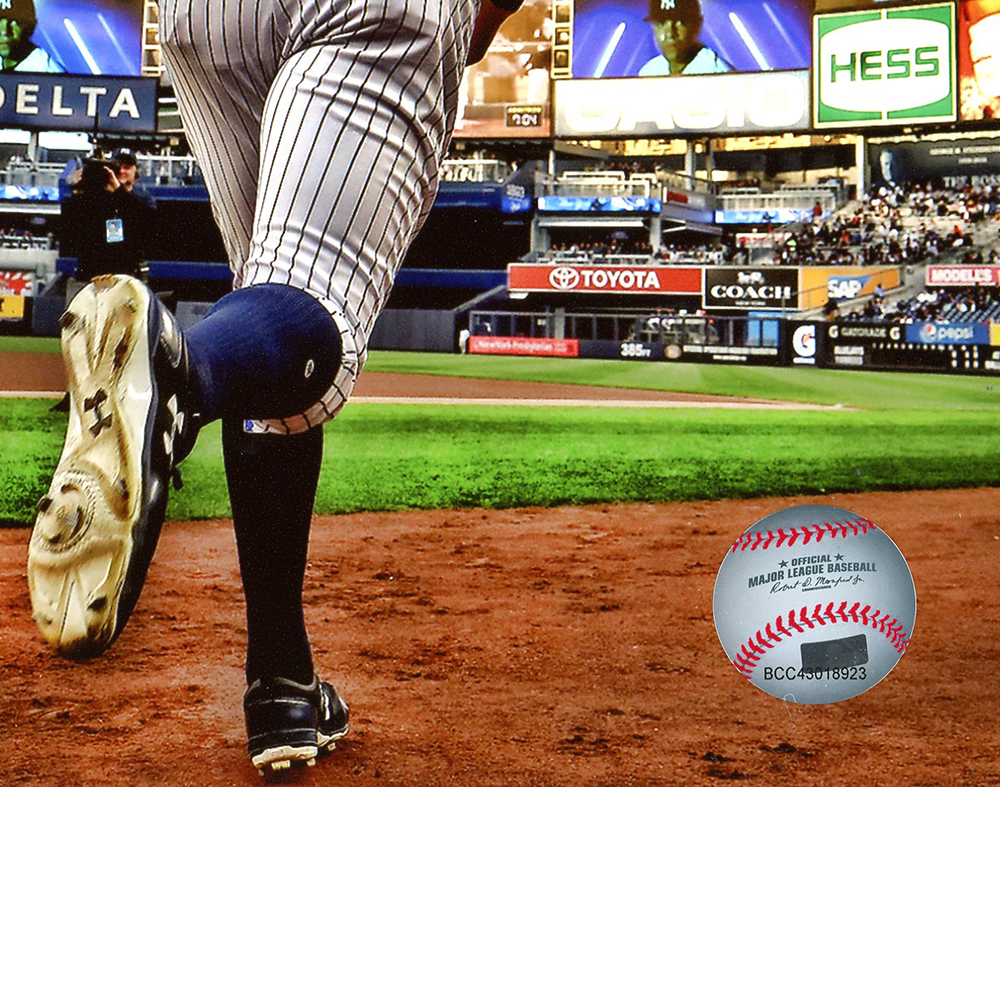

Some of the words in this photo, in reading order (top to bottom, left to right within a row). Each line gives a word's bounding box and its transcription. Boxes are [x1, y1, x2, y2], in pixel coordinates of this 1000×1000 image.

[831, 46, 940, 82] HESS
[581, 271, 660, 288] TOYOTA
[711, 285, 791, 299] COACH
[828, 279, 861, 298] SAP
[937, 326, 973, 340] pepsi
[791, 555, 832, 567] OFFICIAL
[748, 571, 785, 588] MAJOR
[787, 565, 824, 579] LEAGUE
[827, 562, 877, 573] BASEBALL
[764, 667, 867, 680] BCC43018923
